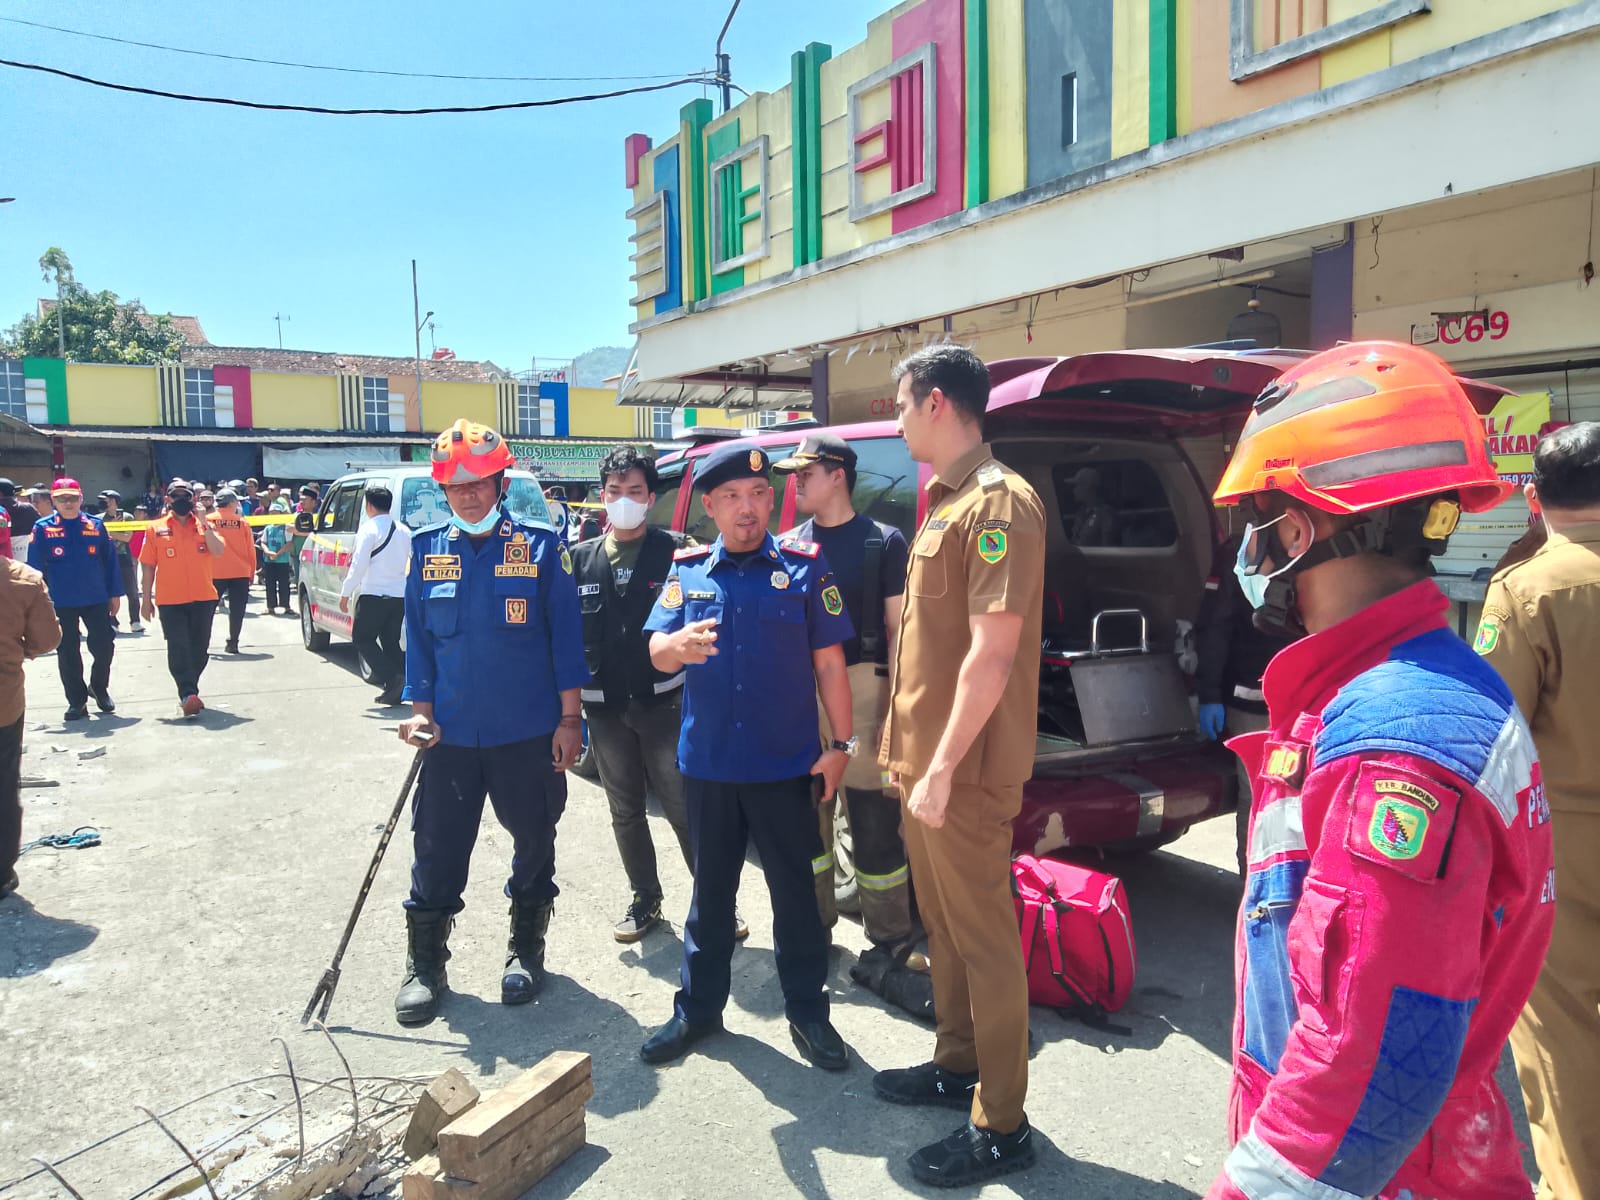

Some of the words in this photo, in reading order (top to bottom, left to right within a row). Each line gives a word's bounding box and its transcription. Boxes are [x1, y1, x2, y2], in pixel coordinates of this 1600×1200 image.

[1438, 310, 1510, 345] C69
[512, 445, 542, 459] KIOS
[543, 447, 576, 459] BUAH
